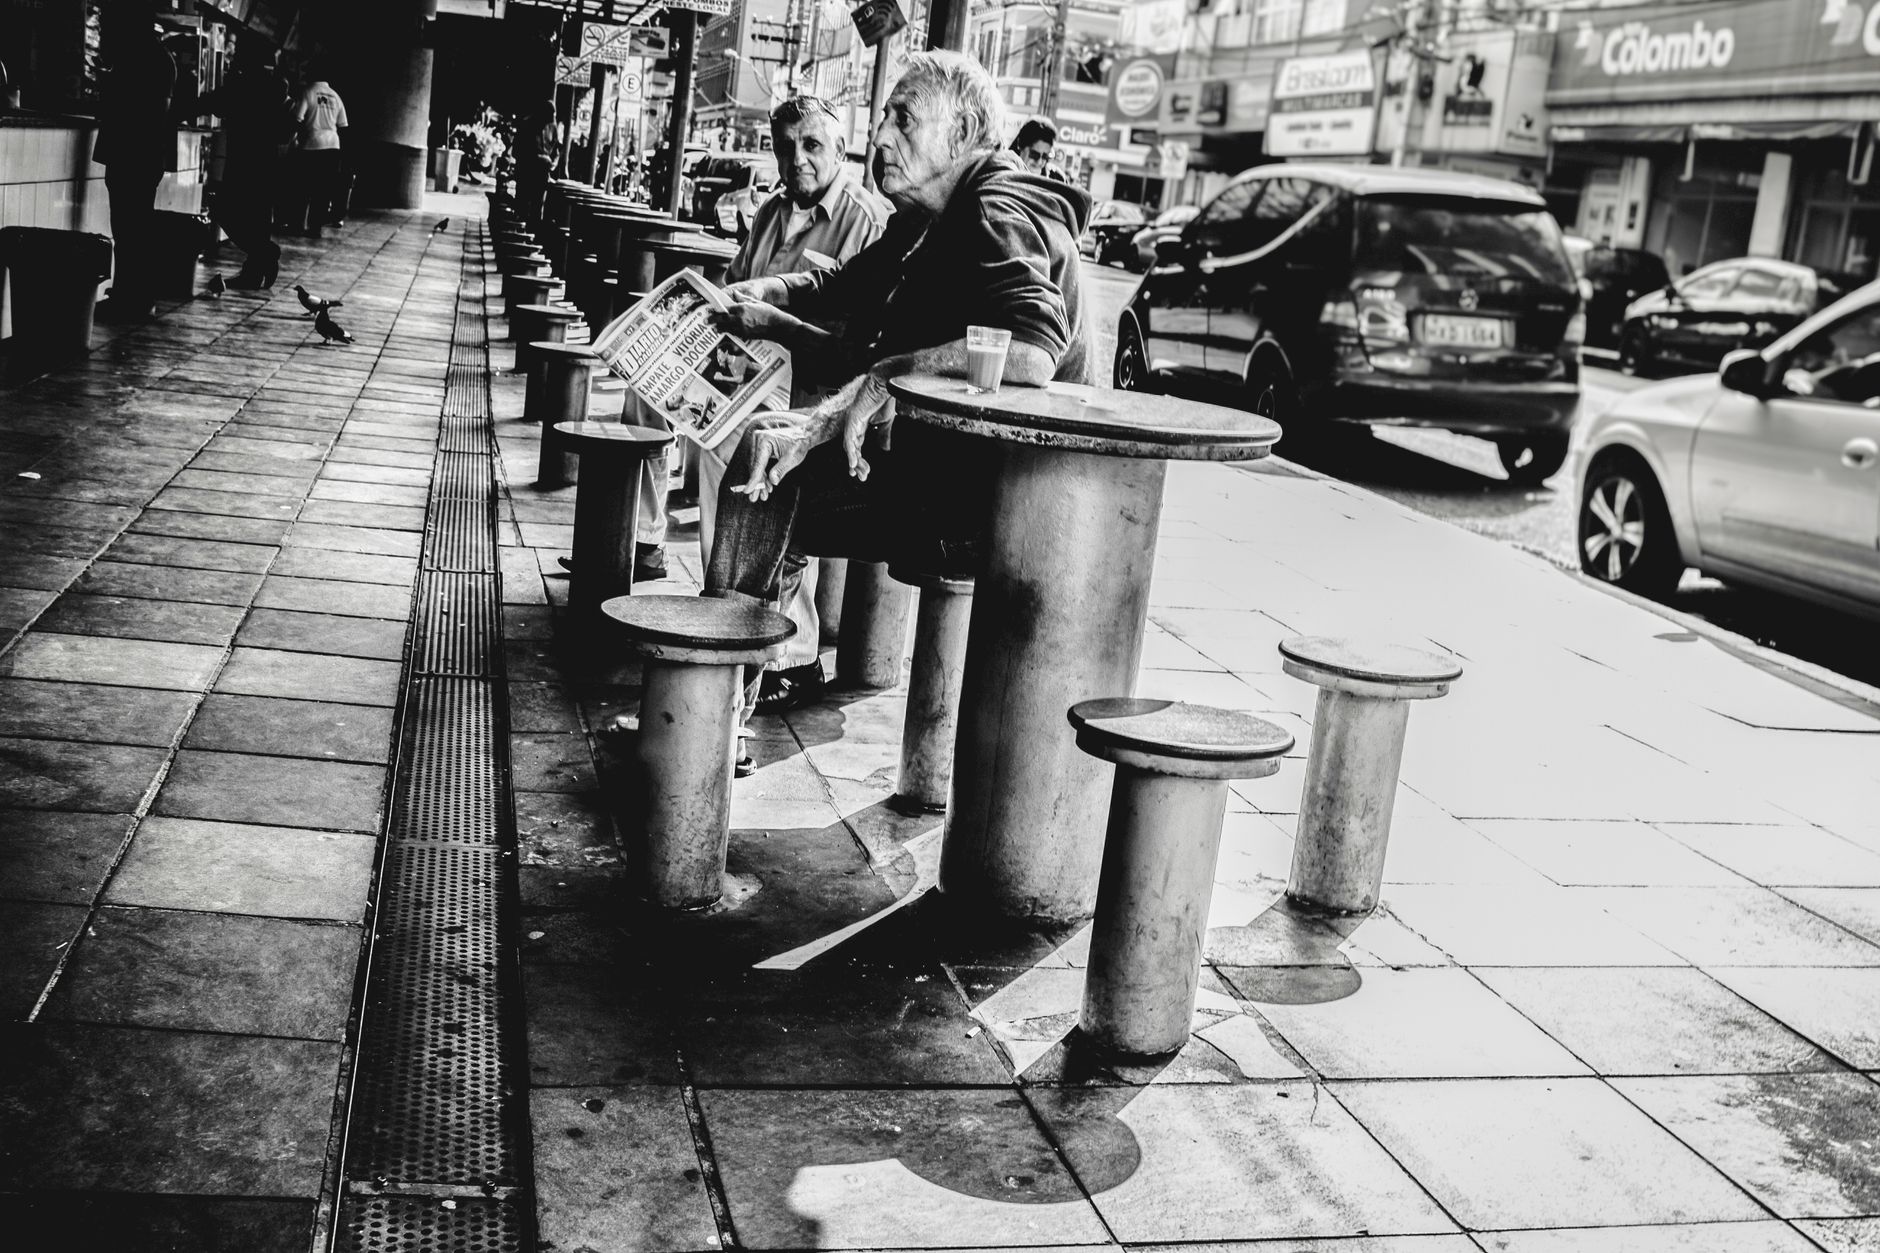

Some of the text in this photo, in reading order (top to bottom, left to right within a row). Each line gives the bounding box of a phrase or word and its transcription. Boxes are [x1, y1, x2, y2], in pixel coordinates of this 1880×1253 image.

[663, 0, 728, 13] NESTE LOCAL
[1601, 20, 1735, 76] Colombo
[628, 78, 634, 89] E
[1060, 125, 1103, 145] Claro
[673, 323, 708, 357] VITÓRIA
[638, 361, 671, 396] EMPATE
[649, 365, 685, 404] AMARGO
